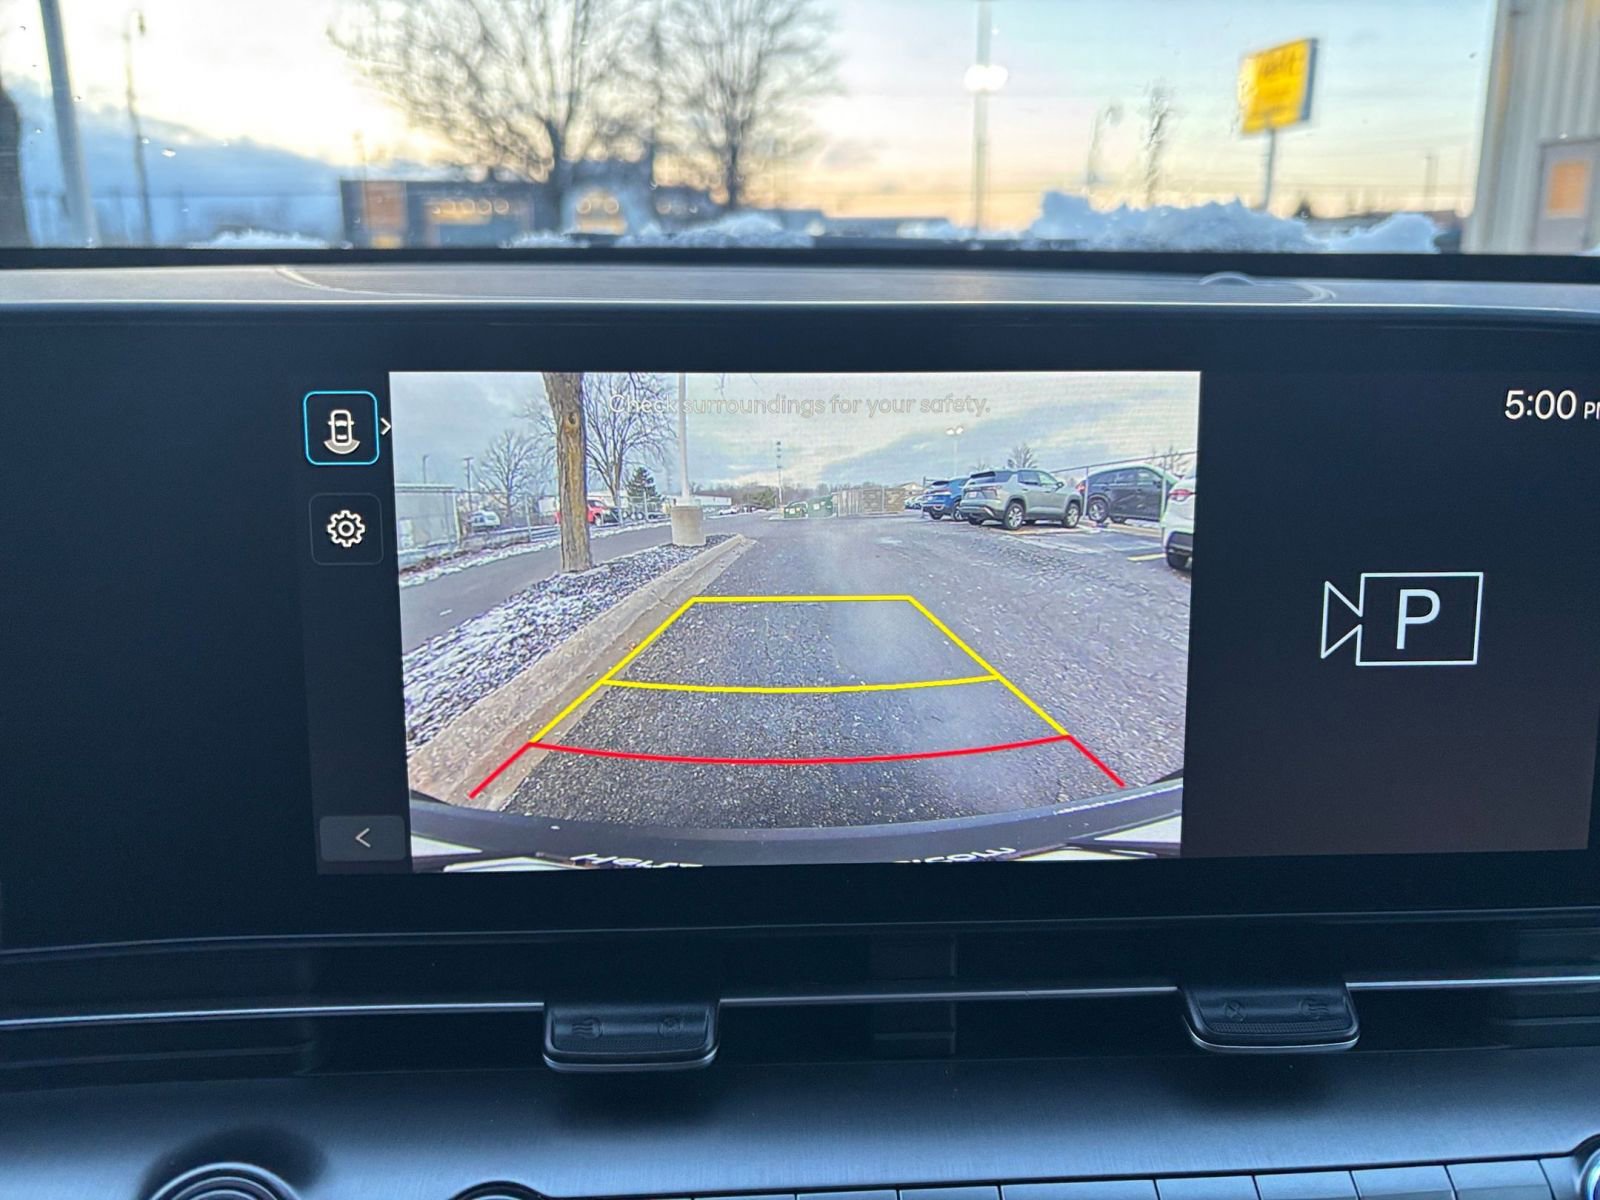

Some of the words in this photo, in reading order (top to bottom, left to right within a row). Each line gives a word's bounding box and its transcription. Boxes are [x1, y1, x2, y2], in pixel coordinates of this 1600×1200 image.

[609, 393, 677, 414] Check
[683, 393, 826, 419] surroundings
[829, 393, 863, 414] for
[866, 399, 916, 418] your
[919, 393, 991, 418] safety.
[1504, 389, 1577, 420] 5:00
[1396, 588, 1441, 650] P
